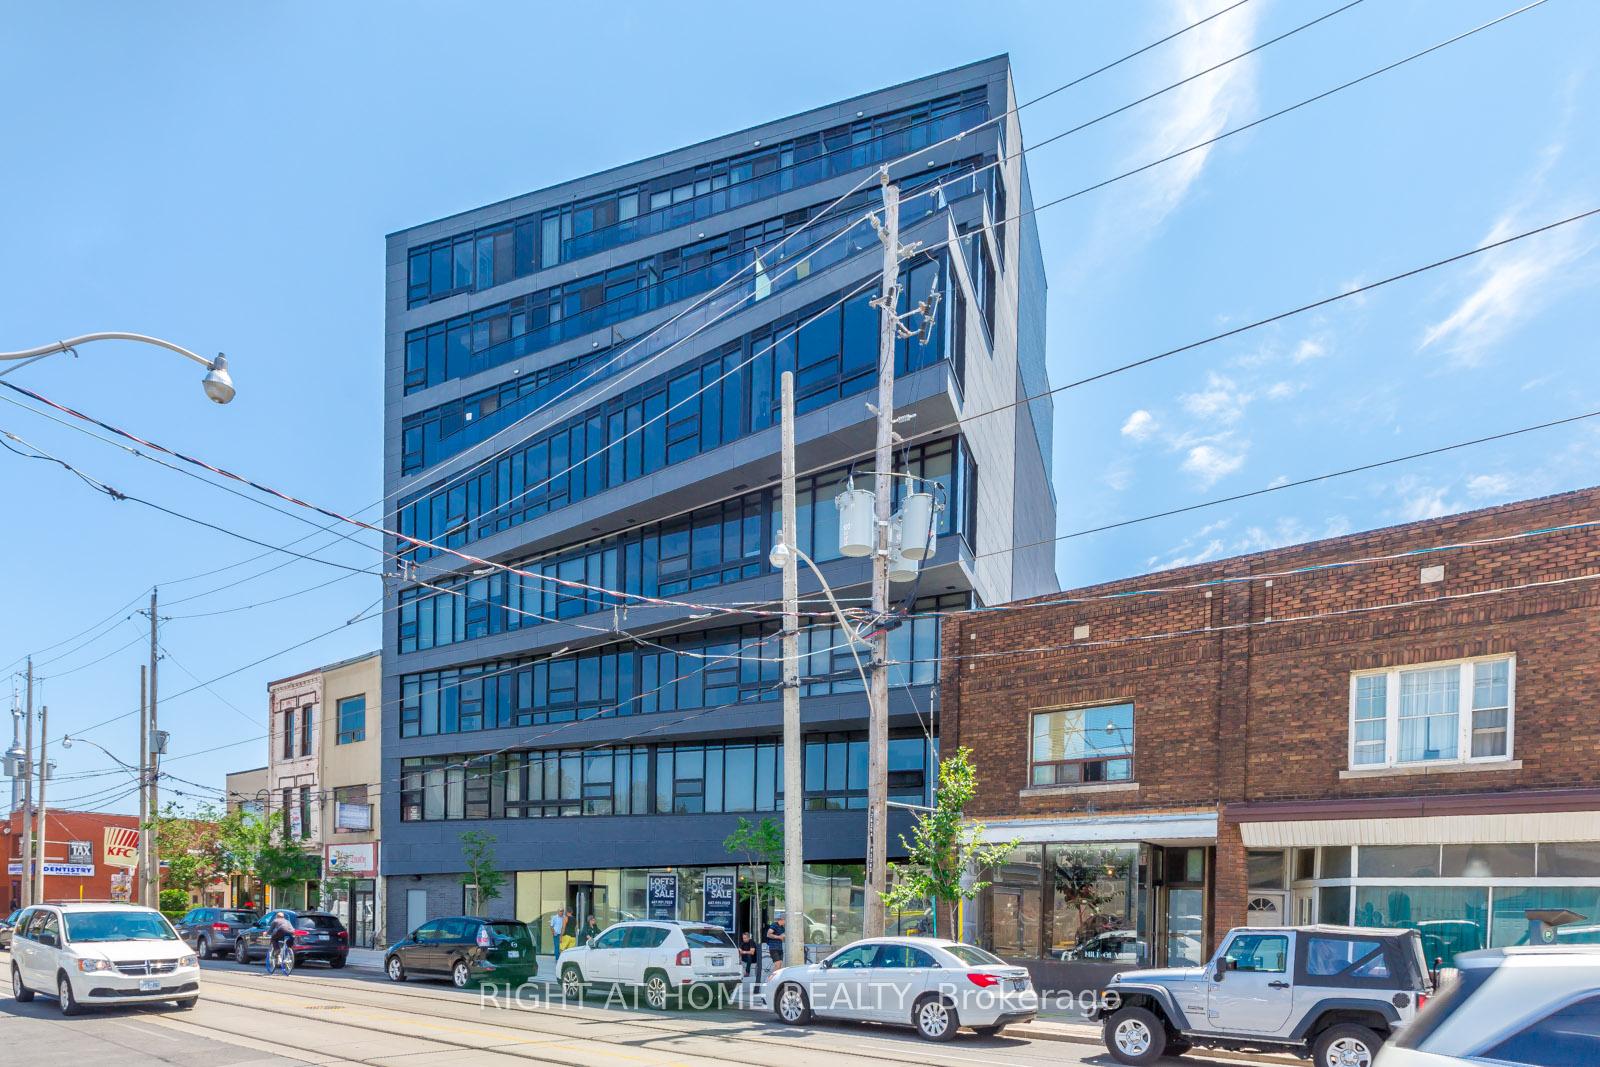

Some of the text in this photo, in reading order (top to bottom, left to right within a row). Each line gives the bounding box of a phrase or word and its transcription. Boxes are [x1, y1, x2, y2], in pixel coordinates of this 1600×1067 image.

[71, 846, 91, 856] TAX
[107, 847, 133, 858] KFC
[654, 890, 675, 898] SALE
[711, 890, 732, 898] SALE
